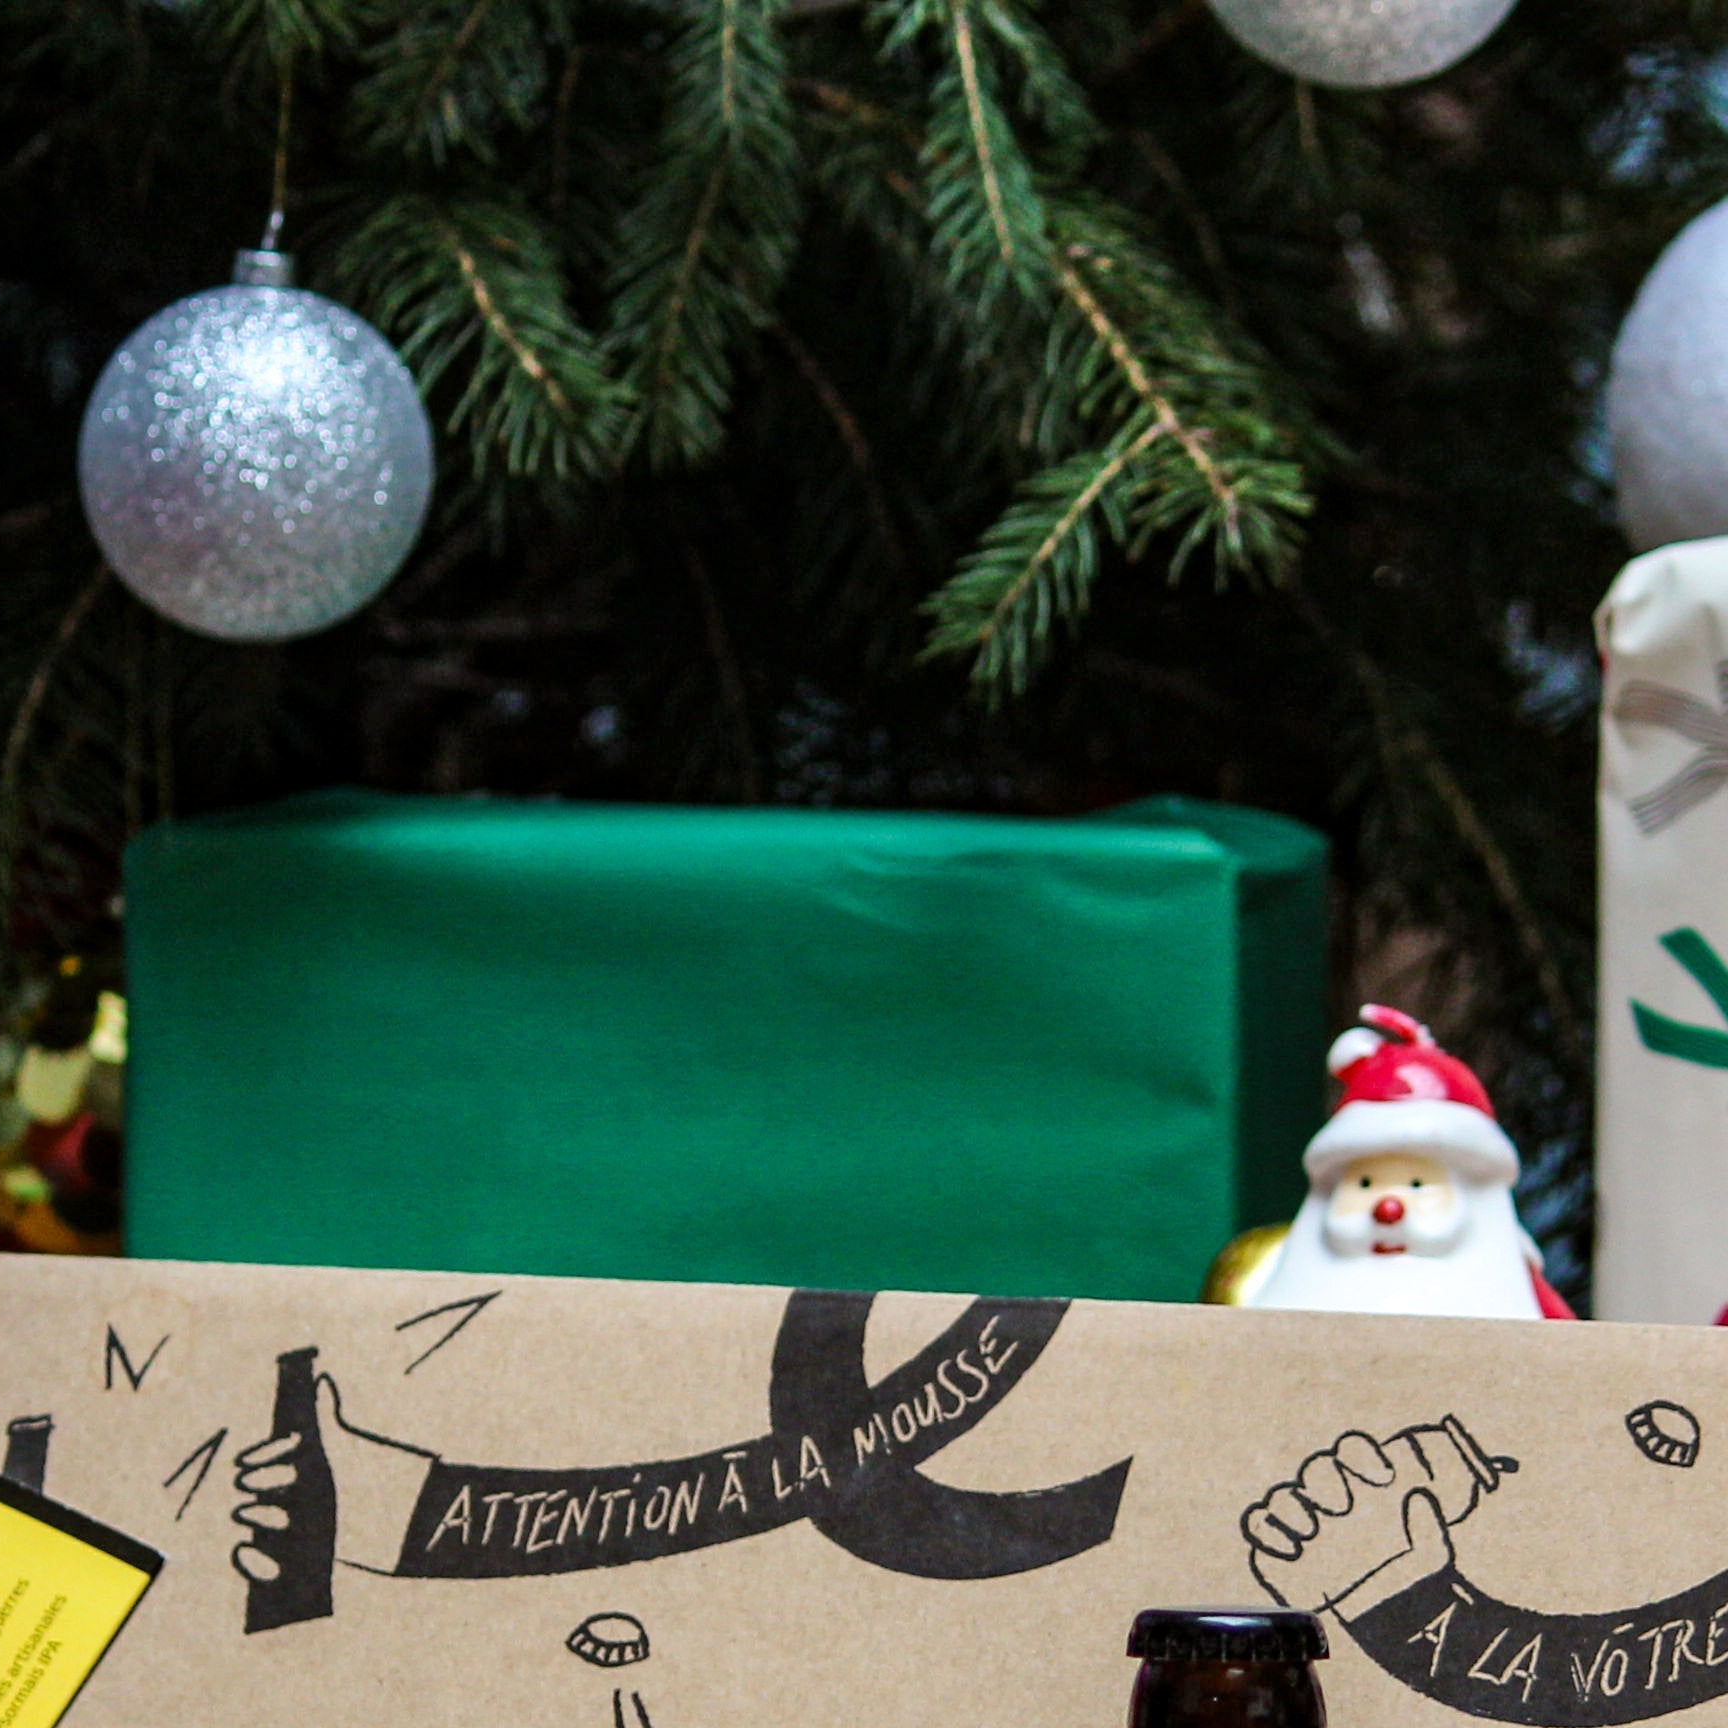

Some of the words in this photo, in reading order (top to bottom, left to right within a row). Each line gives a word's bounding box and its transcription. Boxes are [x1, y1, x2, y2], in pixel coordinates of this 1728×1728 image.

[772, 1435, 832, 1500] LA
[852, 1315, 1019, 1467] MOUSSE
[6, 1595, 68, 1679] artisanales
[37, 1640, 62, 1666] IPA
[1468, 1627, 1544, 1703] LA
